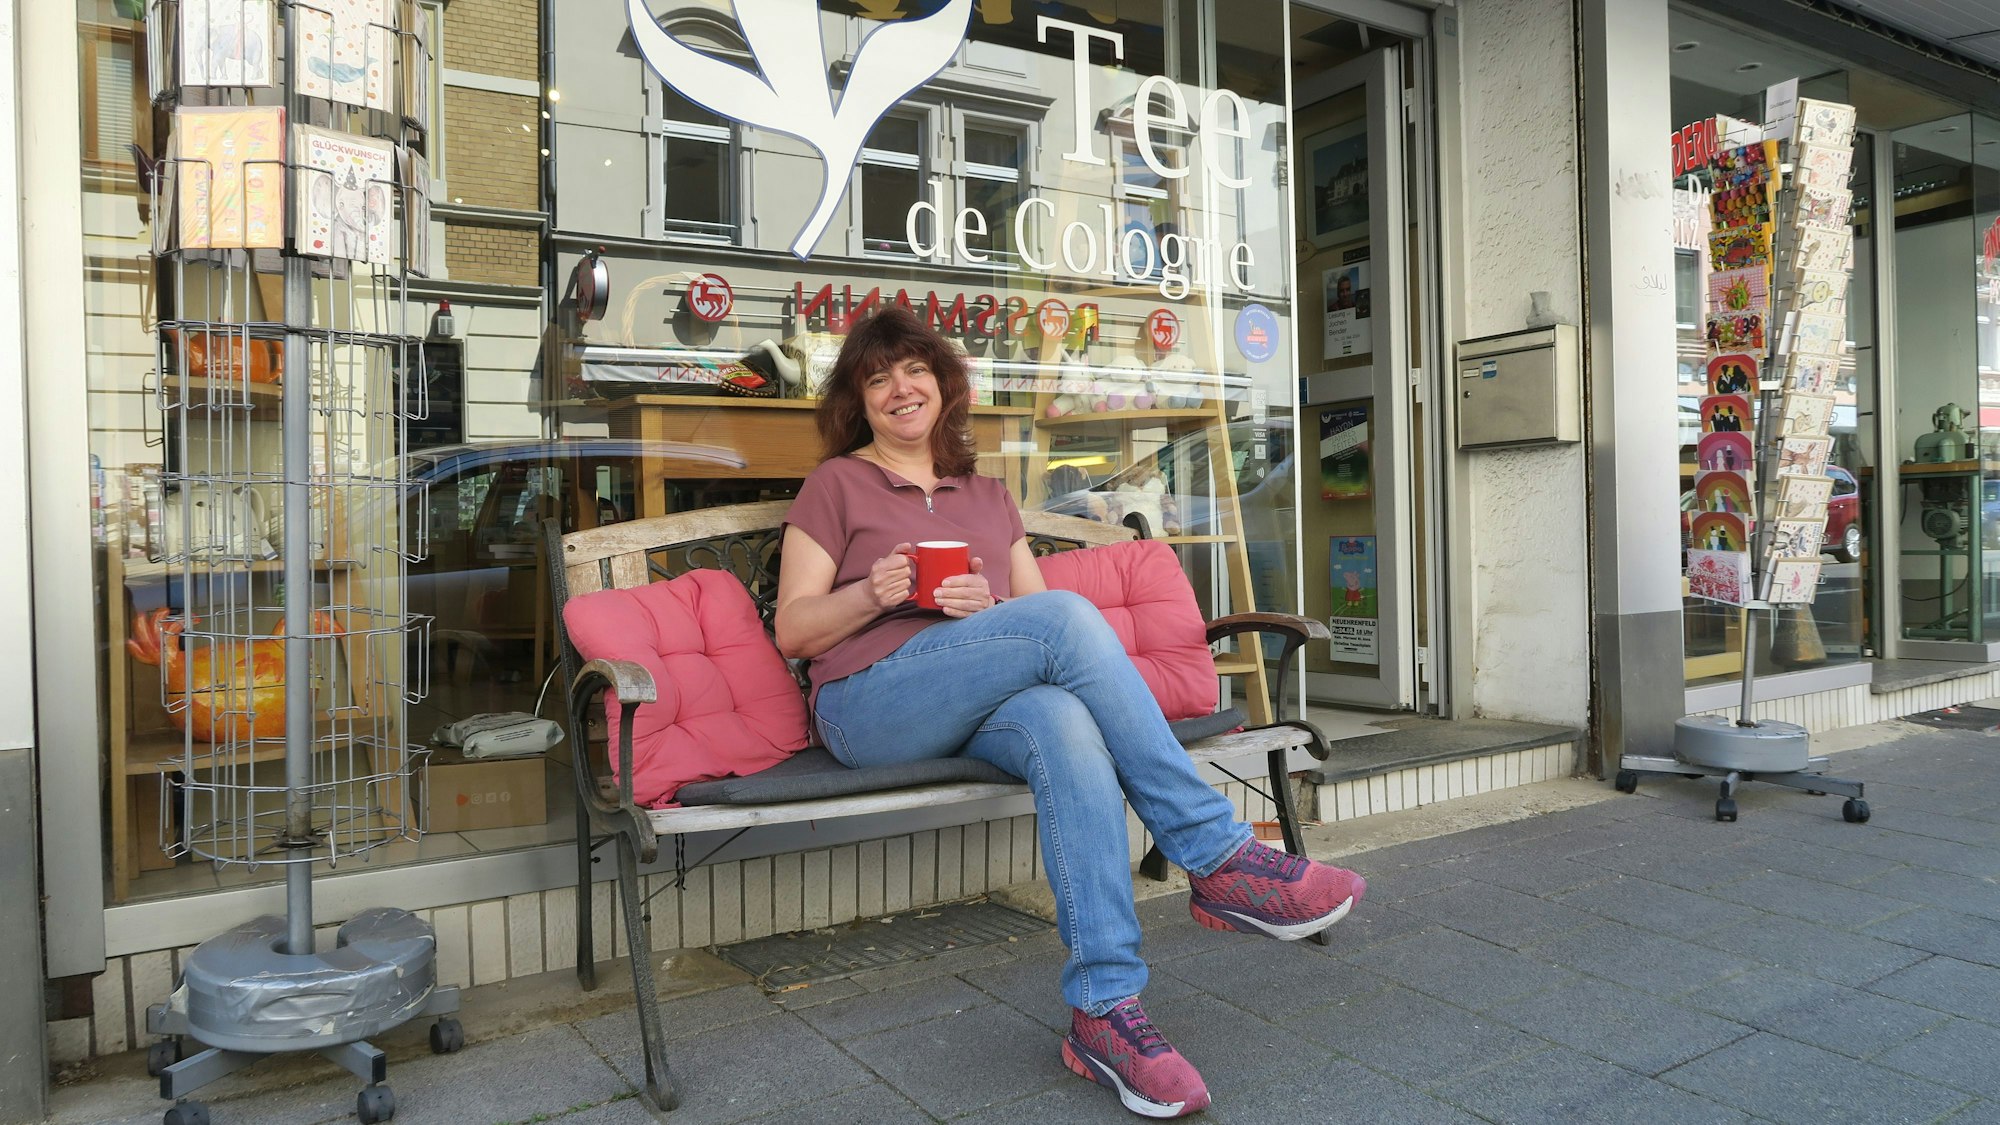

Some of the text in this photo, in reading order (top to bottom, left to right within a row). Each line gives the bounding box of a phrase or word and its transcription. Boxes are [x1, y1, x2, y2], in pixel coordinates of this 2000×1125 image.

[1037, 15, 1253, 189] Tee
[312, 140, 386, 162] GLÜCKWUNSCH
[906, 179, 1255, 300] de Cologne
[1328, 327, 1347, 337] Bender
[1330, 420, 1354, 436] HAYDN
[1332, 619, 1377, 627] NEUEHRENFELD
